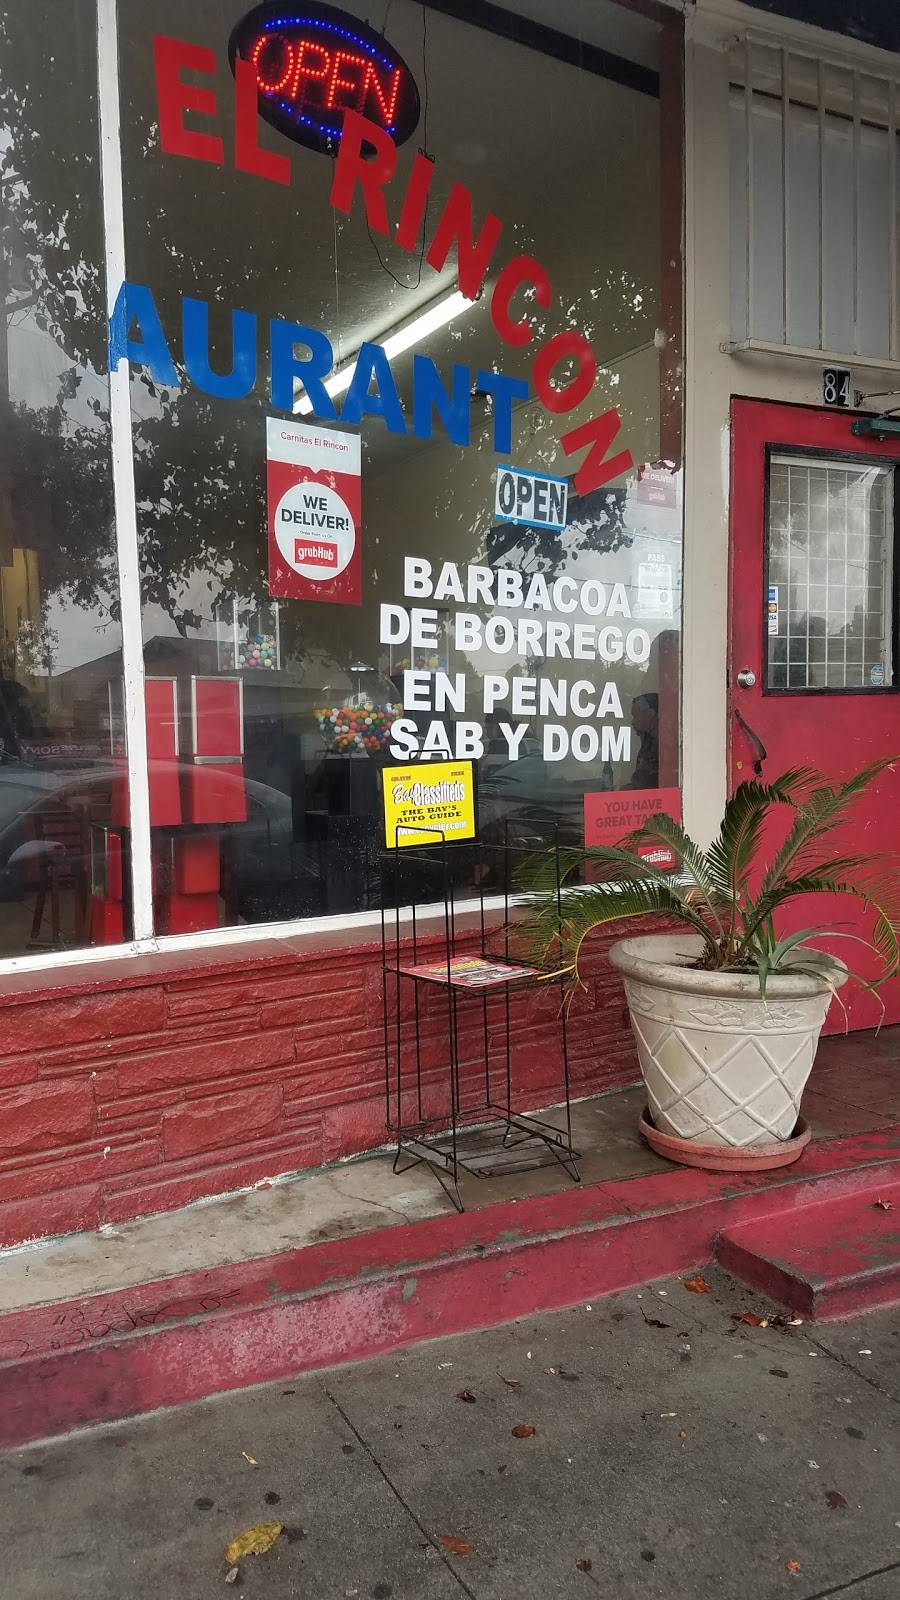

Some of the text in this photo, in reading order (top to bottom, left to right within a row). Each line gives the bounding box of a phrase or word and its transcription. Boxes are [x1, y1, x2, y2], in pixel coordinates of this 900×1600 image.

[152, 34, 635, 498] EL RINCON
[107, 280, 530, 456] AURANT
[824, 372, 851, 406] 84
[280, 431, 349, 452] Carnitas El Rincon
[303, 494, 328, 511] WE
[499, 472, 566, 525] OPEN
[281, 508, 350, 531] DELIVER!
[404, 556, 632, 618] BARBACOA
[380, 603, 651, 664] DE BORREGO
[403, 670, 624, 719] EN PENCA
[389, 718, 632, 762] SAB Y DOM
[396, 811, 462, 824] AUTO GUIDE
[401, 804, 457, 816] THE BAY'S
[595, 815, 633, 828] GREAT
[604, 799, 662, 813] YOU HAVE
